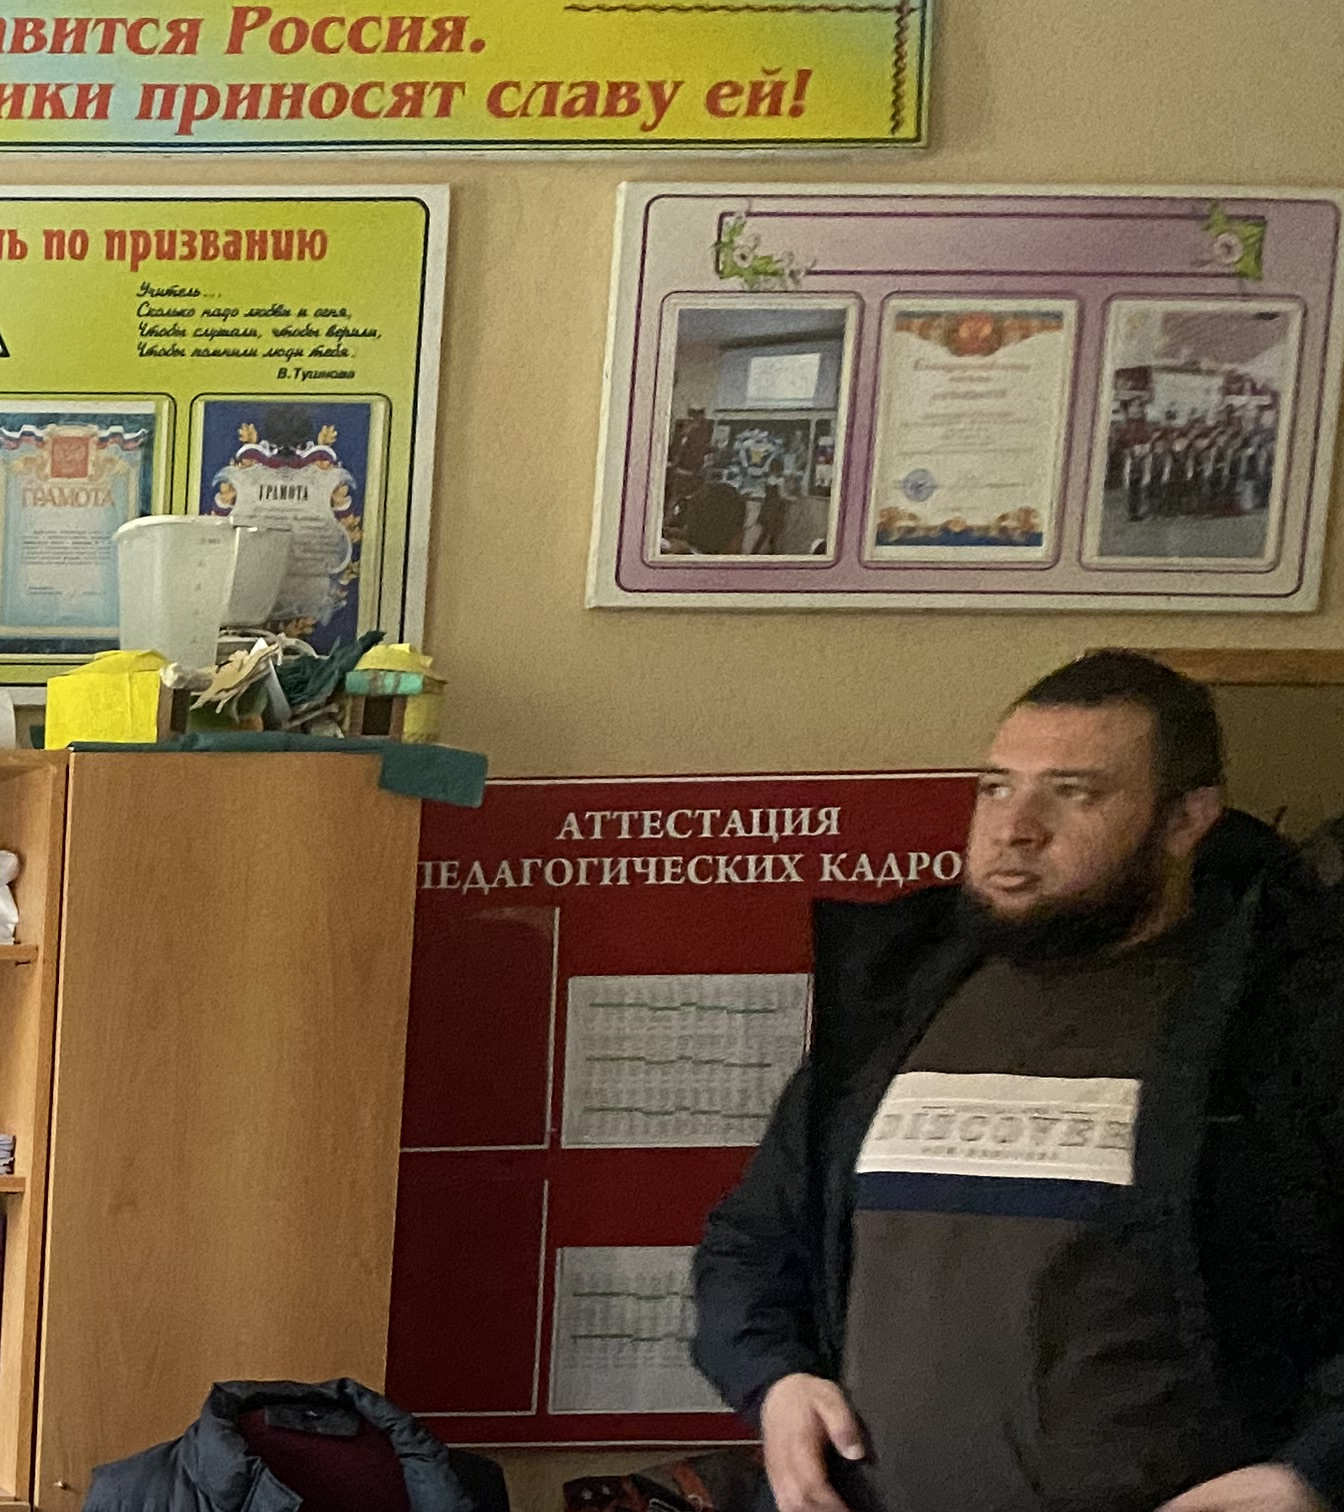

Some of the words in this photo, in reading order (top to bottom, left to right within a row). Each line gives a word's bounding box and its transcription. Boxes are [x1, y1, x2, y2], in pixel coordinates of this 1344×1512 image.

[225, 5, 487, 56] Россия.
[135, 80, 466, 136] приносят
[485, 79, 685, 132] славу
[704, 67, 813, 118] ей!
[42, 229, 89, 261] по
[103, 228, 329, 273] призванию
[136, 300, 196, 318] Сколько
[200, 306, 240, 322] надо
[243, 302, 291, 318] любви
[296, 307, 308, 318] и
[138, 320, 187, 338] Чтобы
[192, 326, 262, 342] слушали,
[271, 321, 320, 338] чтобы
[137, 341, 186, 358] Чтобы
[190, 346, 259, 358] помнили
[262, 347, 304, 362] люди
[20, 486, 117, 508] ГРАМОТА
[258, 484, 309, 501] ГРАМОТА
[555, 807, 842, 843] АТТЕСТАЦИЯ
[819, 850, 963, 888] КАДРО
